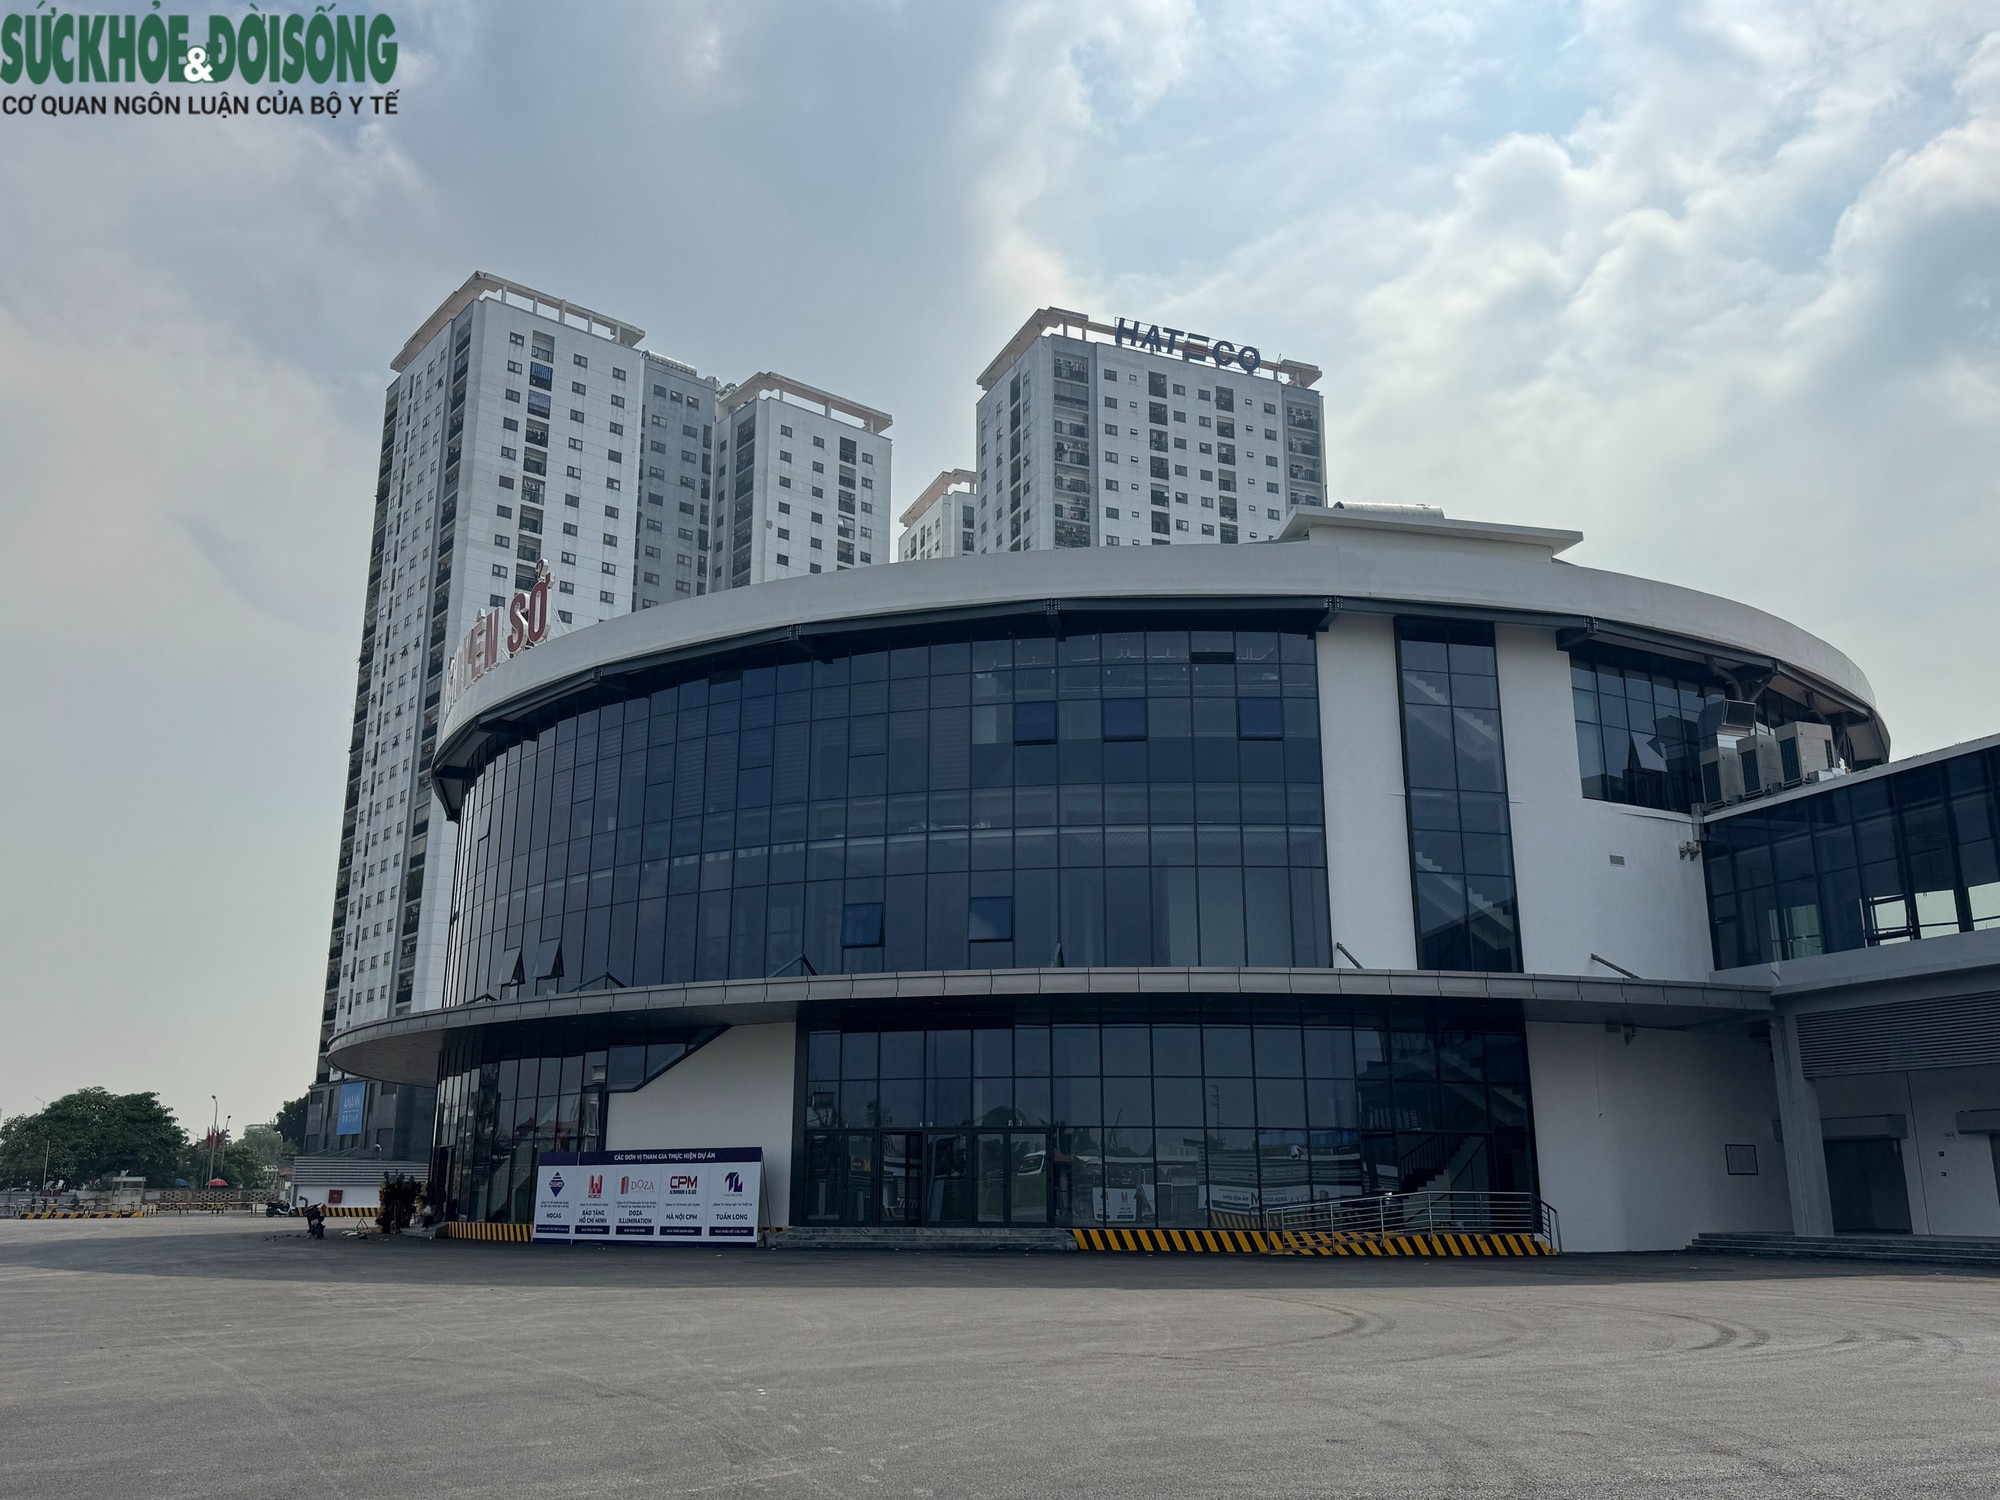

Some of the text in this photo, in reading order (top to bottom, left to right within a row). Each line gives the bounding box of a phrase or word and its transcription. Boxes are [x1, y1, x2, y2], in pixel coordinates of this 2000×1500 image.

[1115, 317, 1261, 373] HATECO
[507, 558, 555, 653] SỞ
[707, 1151, 716, 1159] ÁN
[631, 1179, 655, 1190] DOZA
[669, 1175, 698, 1189] CPM
[666, 1212, 674, 1220] HÀ
[674, 1212, 685, 1222] NỘI
[716, 1212, 732, 1220] TUẤN
